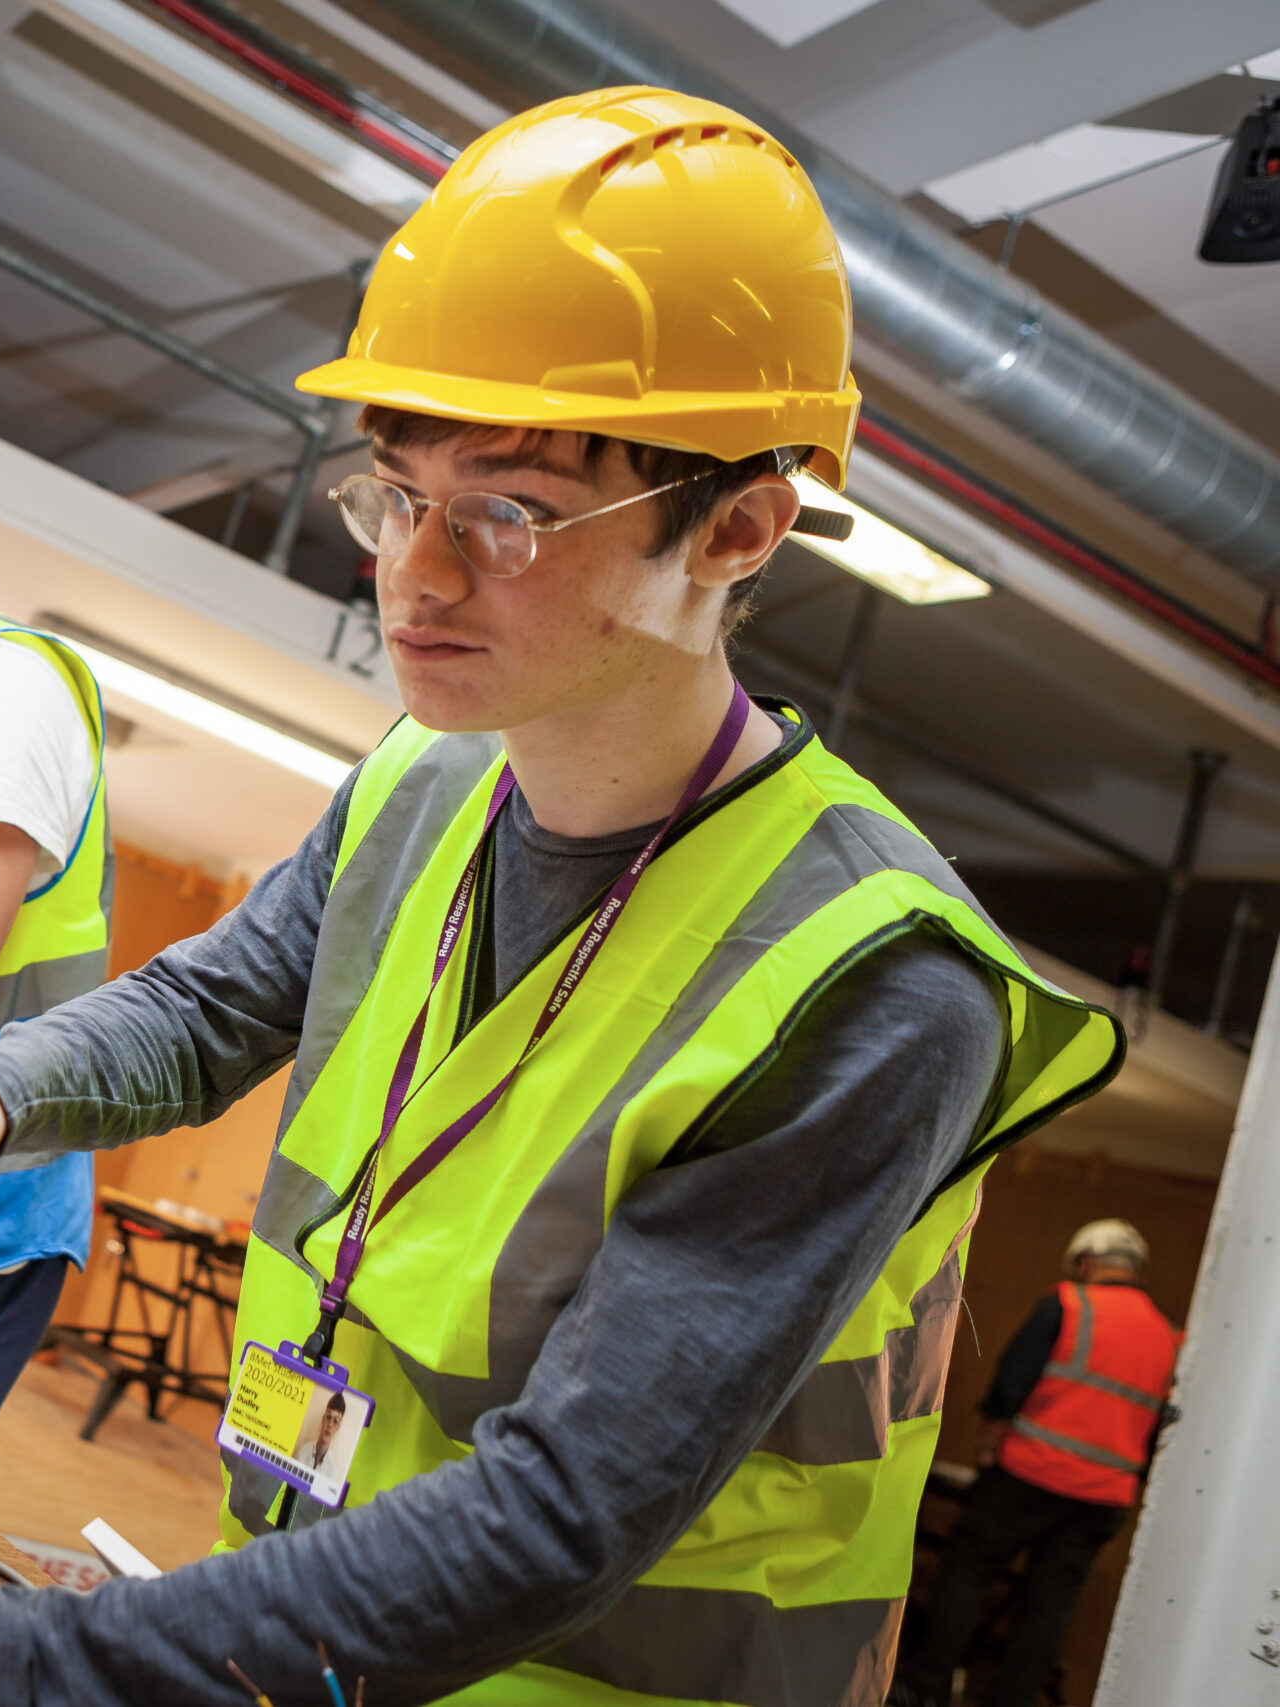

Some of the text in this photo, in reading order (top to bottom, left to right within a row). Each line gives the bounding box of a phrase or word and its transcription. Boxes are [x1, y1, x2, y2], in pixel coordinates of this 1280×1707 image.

[630, 847, 655, 876] Safe
[448, 870, 474, 925] Respectful
[439, 924, 458, 957] Ready
[548, 898, 622, 1013] Ready Respectful Safe
[346, 1204, 368, 1240] Ready
[240, 1383, 259, 1399] Harry
[244, 1364, 306, 1405] 2020/2021
[236, 1393, 260, 1412] Dudley
